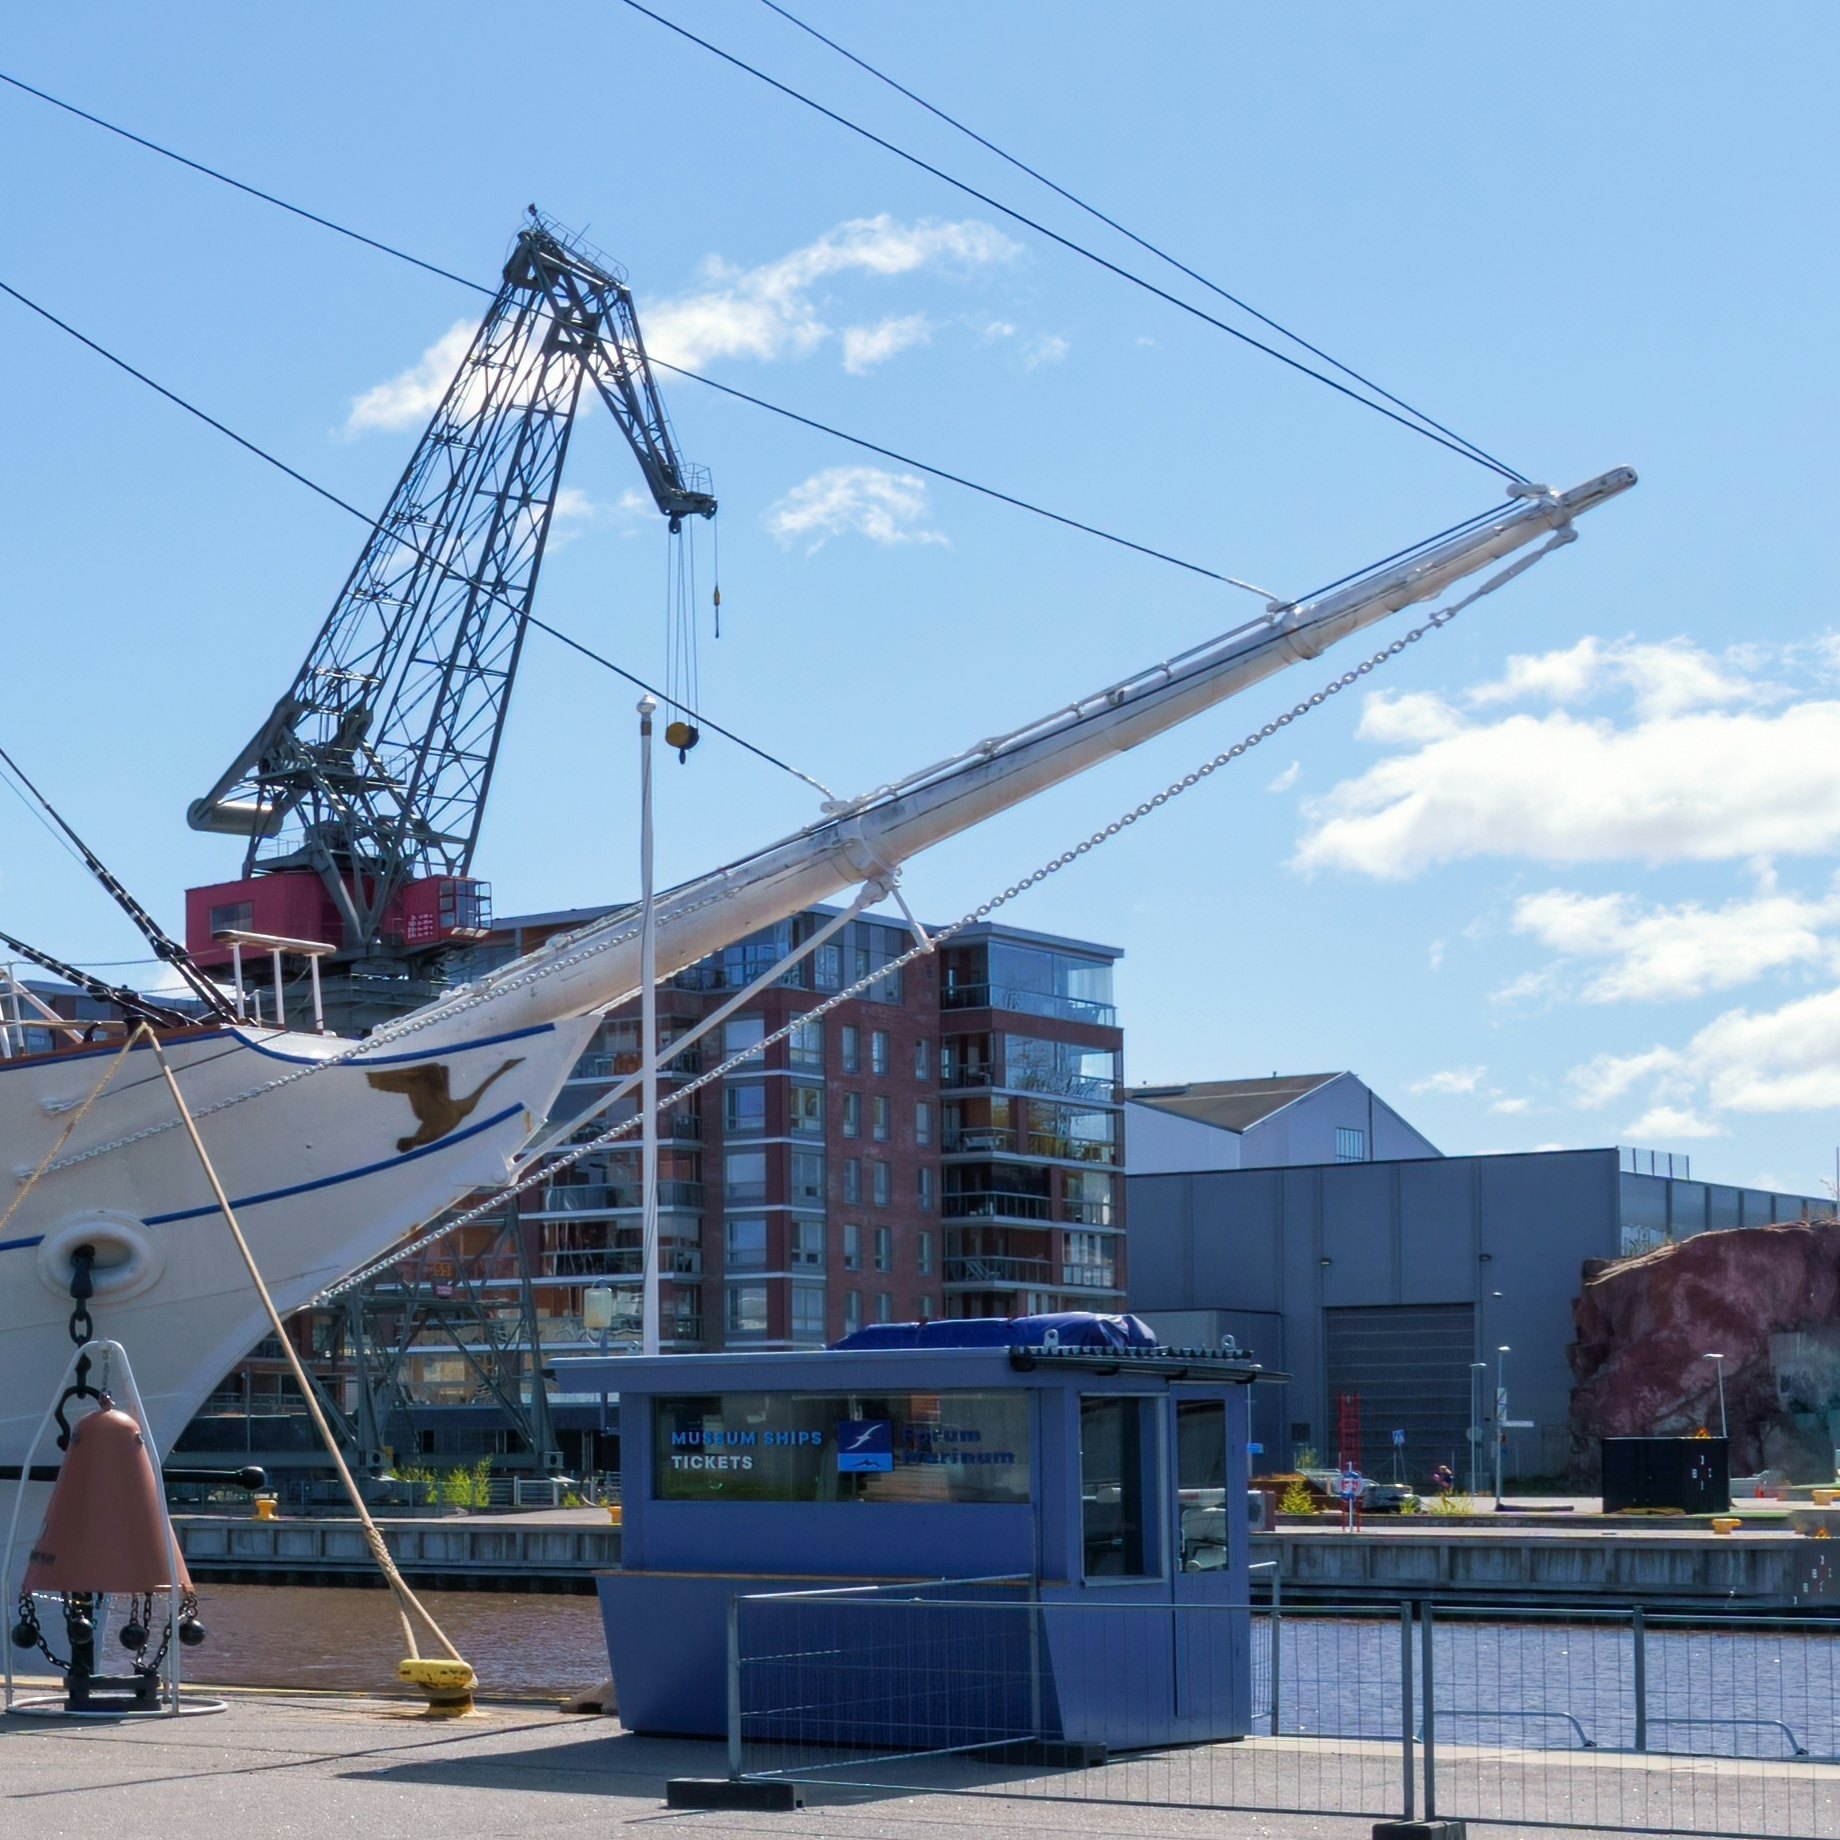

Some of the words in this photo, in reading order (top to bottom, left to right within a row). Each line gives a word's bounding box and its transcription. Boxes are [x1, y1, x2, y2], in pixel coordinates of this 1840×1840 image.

[671, 1431, 757, 1446] MUSEUM
[763, 1431, 822, 1446] SHIPS
[671, 1455, 753, 1470] TICKETS
